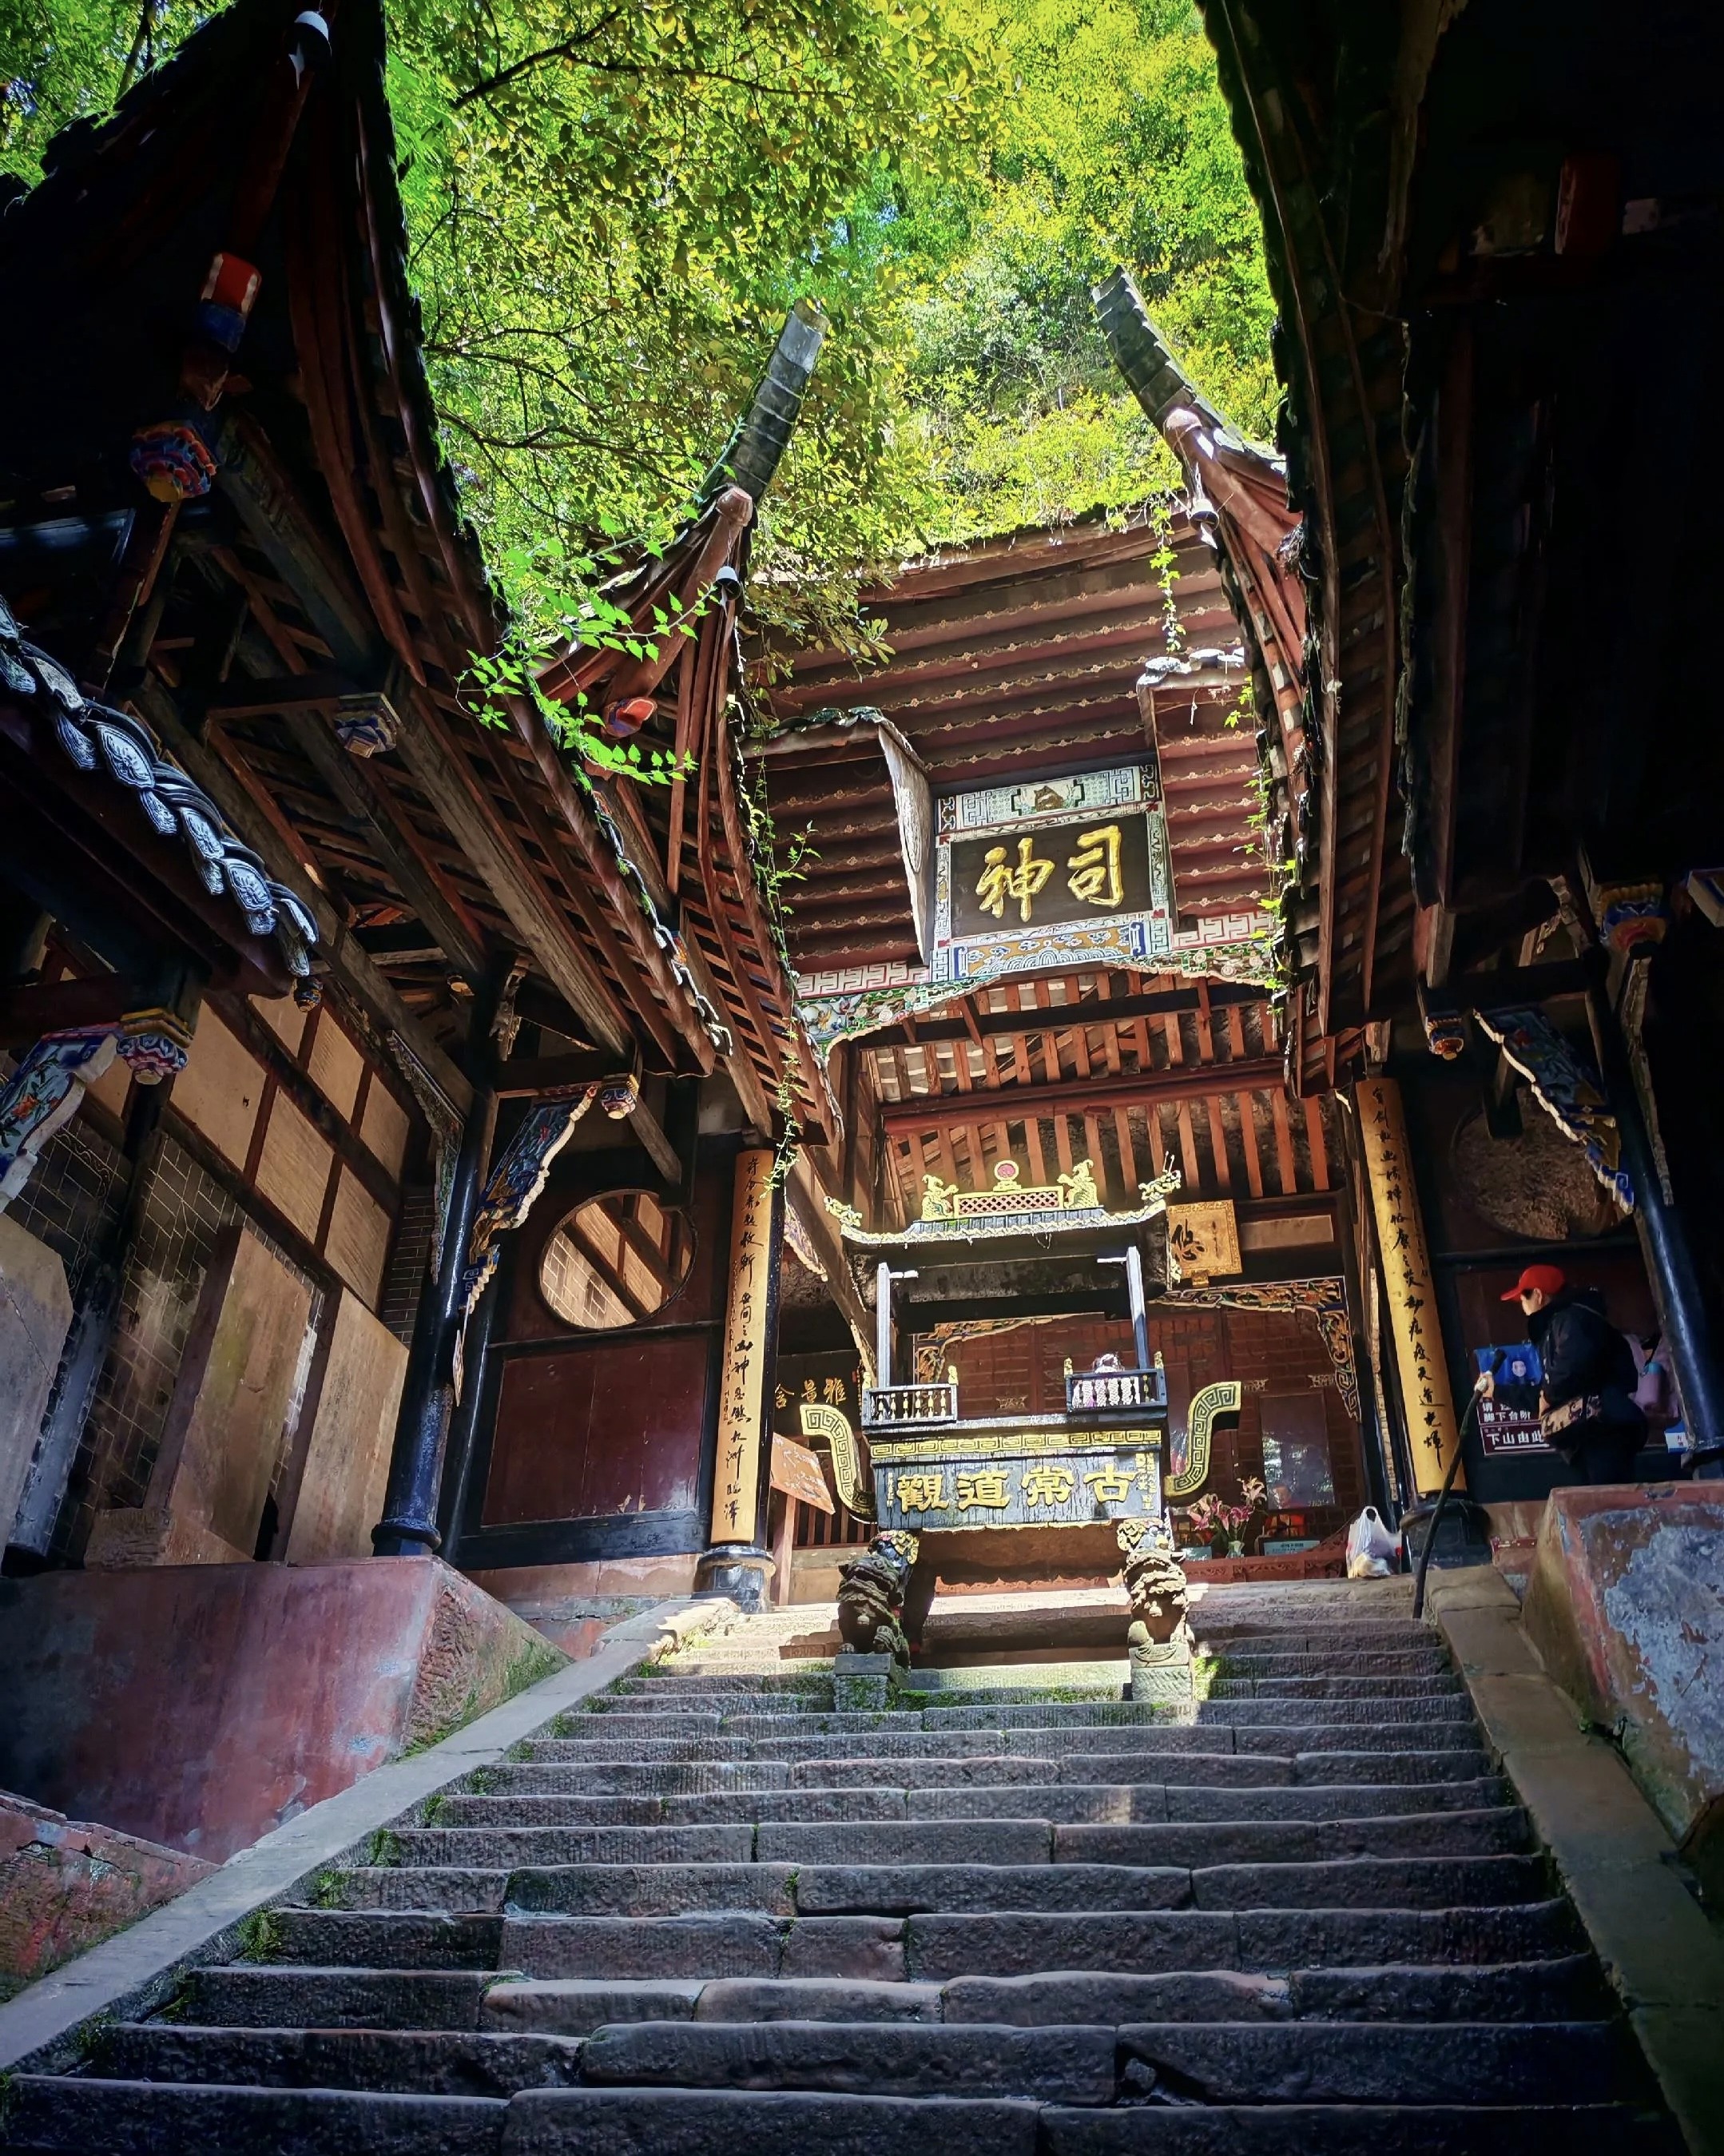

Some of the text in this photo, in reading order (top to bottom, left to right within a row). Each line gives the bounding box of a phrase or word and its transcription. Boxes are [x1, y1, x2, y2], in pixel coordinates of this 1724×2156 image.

[1484, 1410, 1531, 1422] 脚下台阶
[1487, 1430, 1544, 1445] 下山由此
[896, 1464, 1135, 1513] 古常道觀
